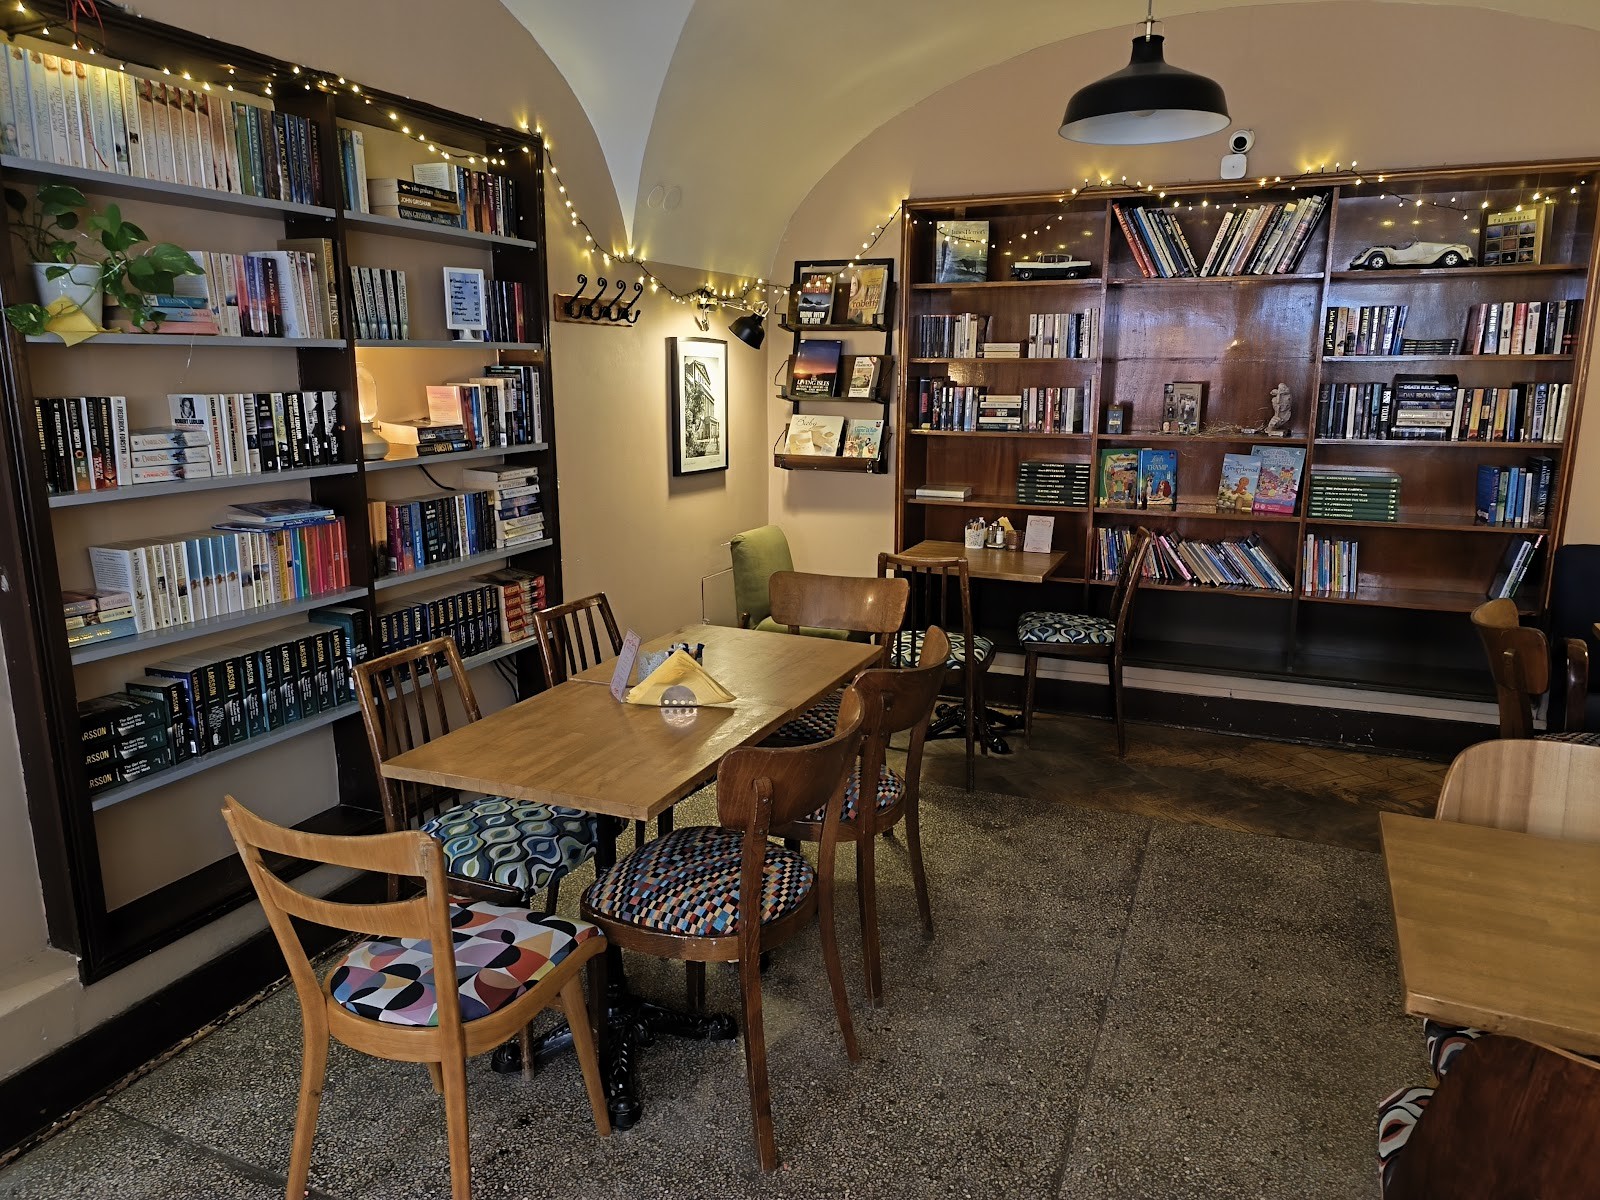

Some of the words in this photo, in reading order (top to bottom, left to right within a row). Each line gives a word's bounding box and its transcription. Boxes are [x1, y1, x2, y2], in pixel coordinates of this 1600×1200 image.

[331, 309, 339, 326] KISS
[244, 396, 257, 435] LUDLUM
[292, 394, 300, 417] ROBERT
[117, 406, 125, 433] FREDERICK
[294, 416, 302, 440] LUDLUM
[413, 607, 421, 632] LARSSON
[299, 640, 308, 668] LARSSON
[315, 635, 325, 663] LARSSON
[332, 630, 341, 657] LARSSON
[245, 656, 254, 685] LARSSON
[264, 651, 273, 679] LARSSON
[281, 645, 291, 674] LARSSON
[206, 666, 217, 697] LARSSON
[225, 661, 236, 690] LARSSON
[81, 726, 107, 742] RSSON
[85, 749, 110, 765] RSSON
[88, 774, 112, 789] RSSON
